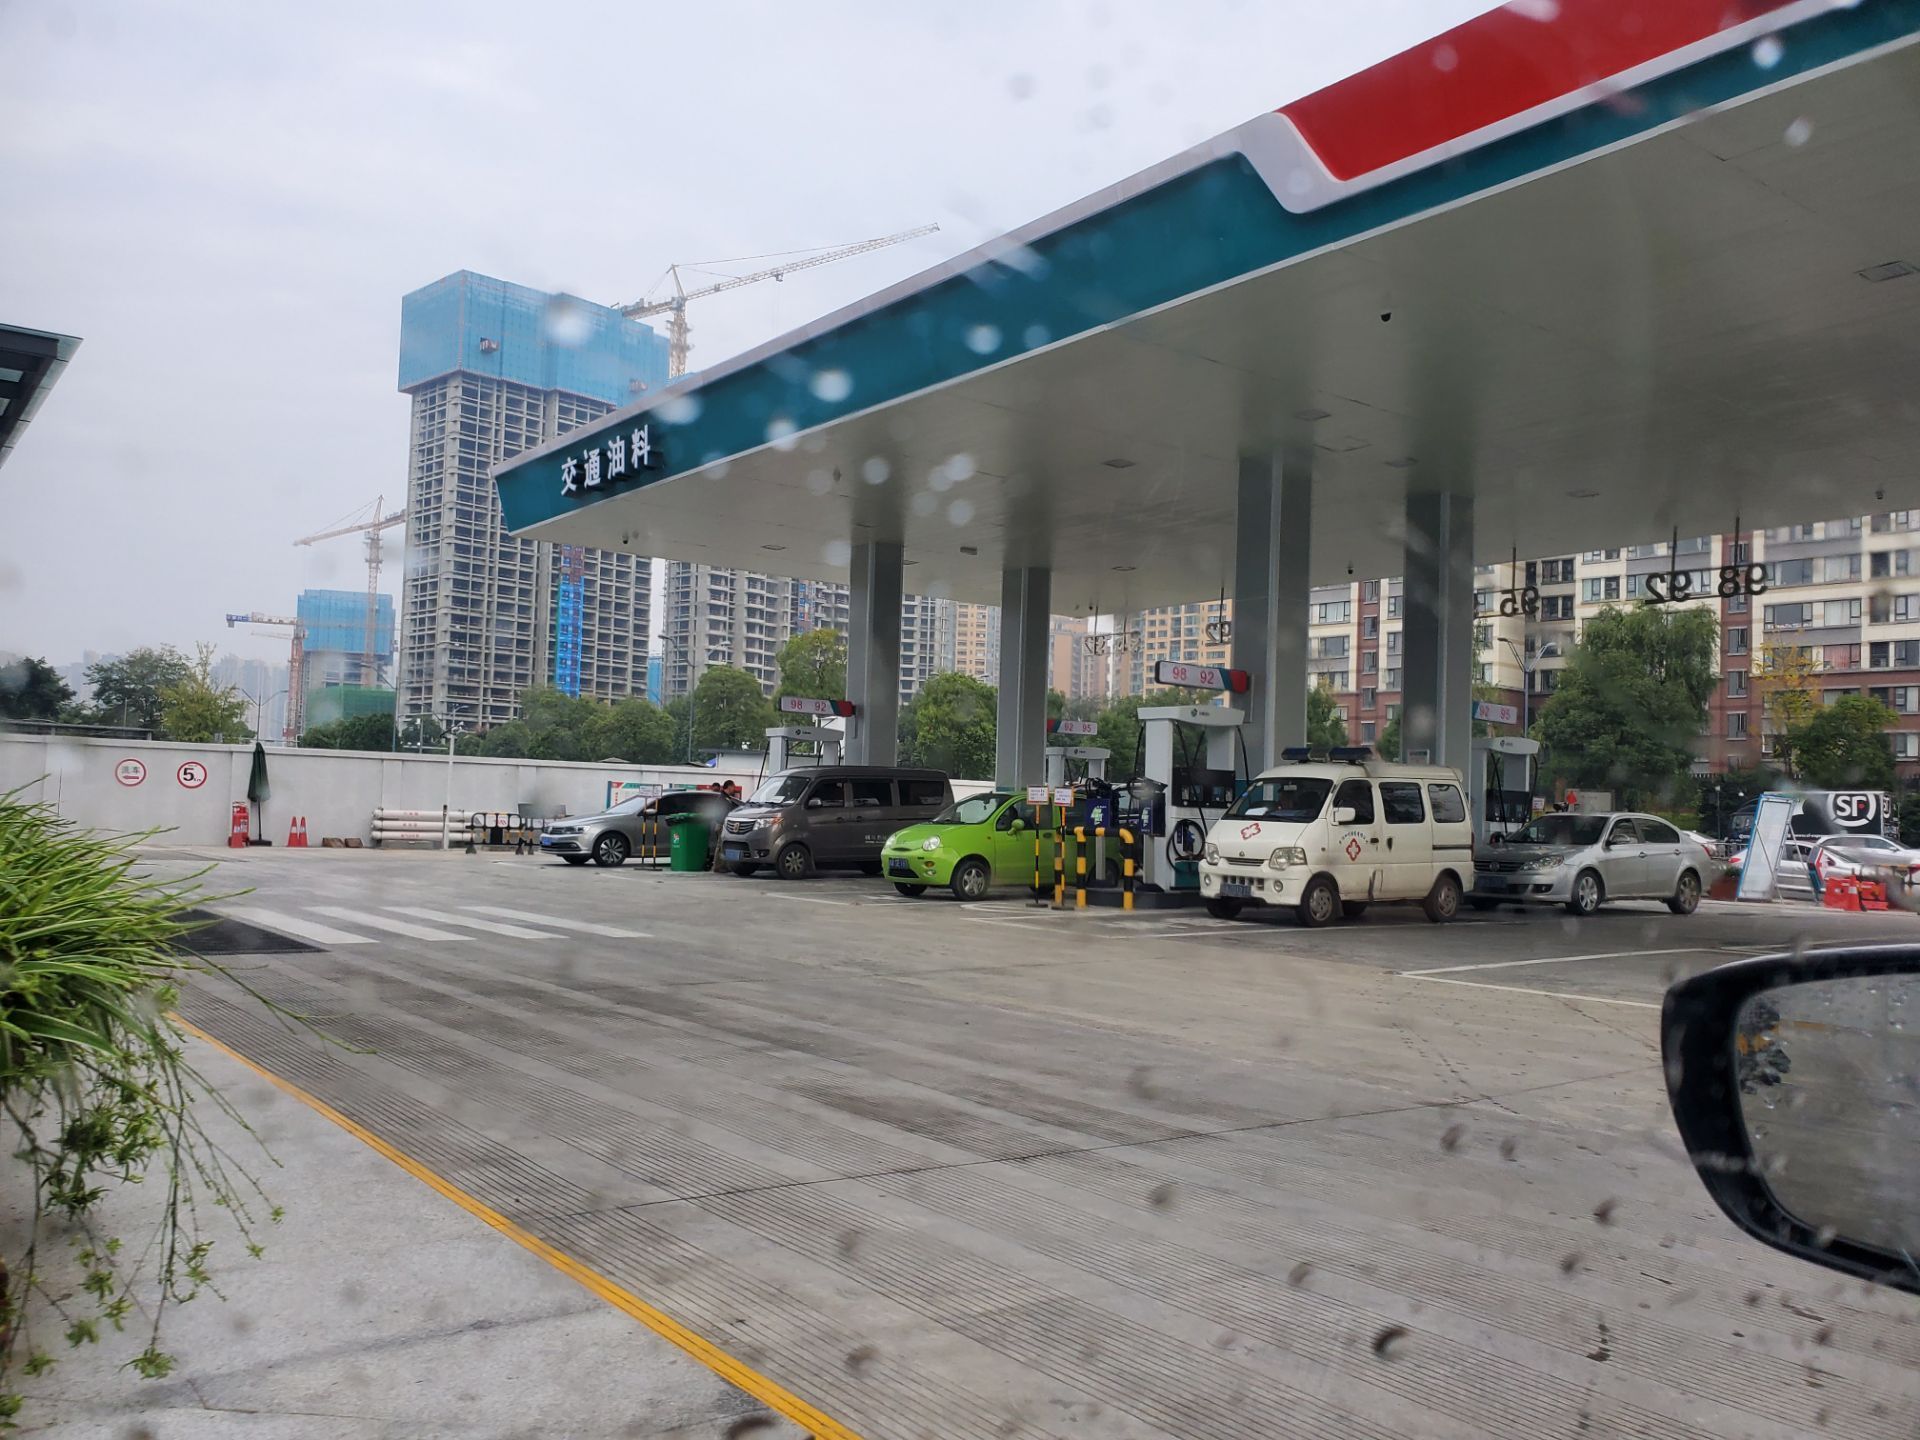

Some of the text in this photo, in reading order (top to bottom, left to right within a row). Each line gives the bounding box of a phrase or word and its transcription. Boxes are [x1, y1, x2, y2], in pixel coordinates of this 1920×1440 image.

[561, 424, 651, 496] 交通油料
[1172, 666, 1215, 685] 98 92
[790, 700, 827, 712] 98 92
[1064, 722, 1092, 733] 92 95
[183, 767, 194, 782] 5
[1836, 795, 1867, 817] SF
